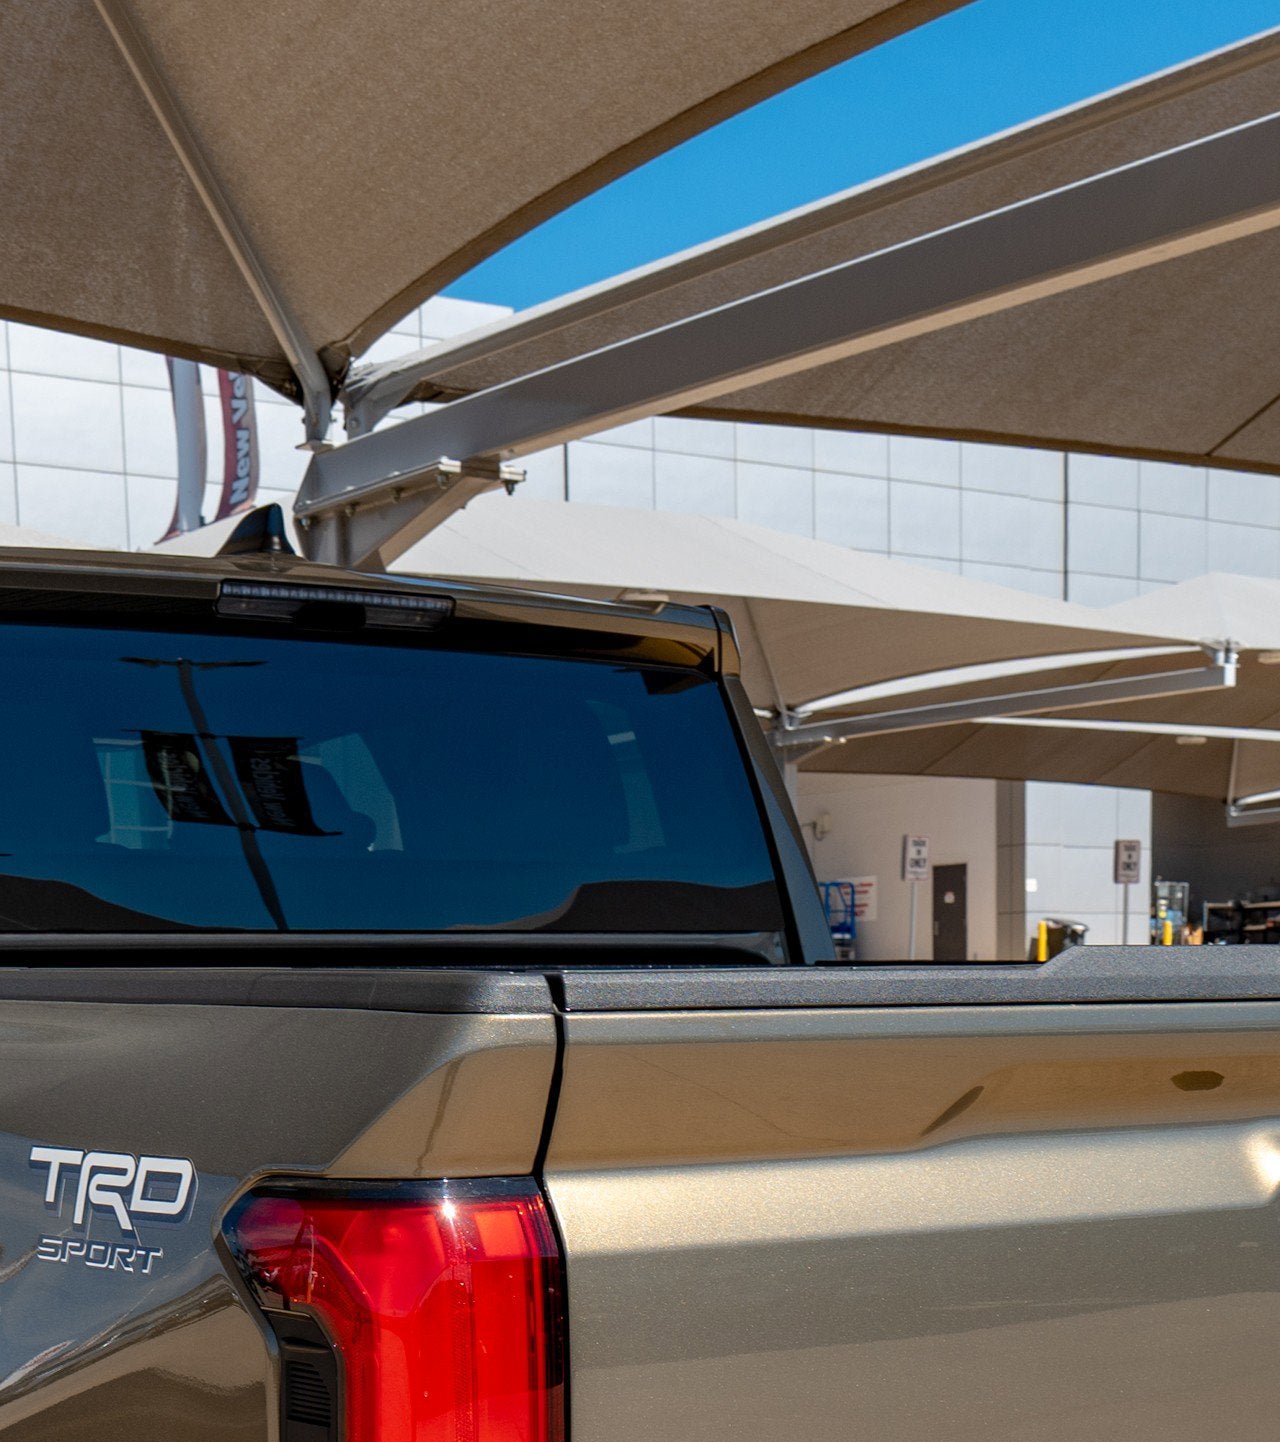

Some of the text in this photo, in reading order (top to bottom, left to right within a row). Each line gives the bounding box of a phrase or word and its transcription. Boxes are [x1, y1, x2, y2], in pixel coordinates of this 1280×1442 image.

[229, 428, 251, 505] New
[29, 1145, 195, 1234] TRD
[36, 1234, 163, 1275] SPORT
